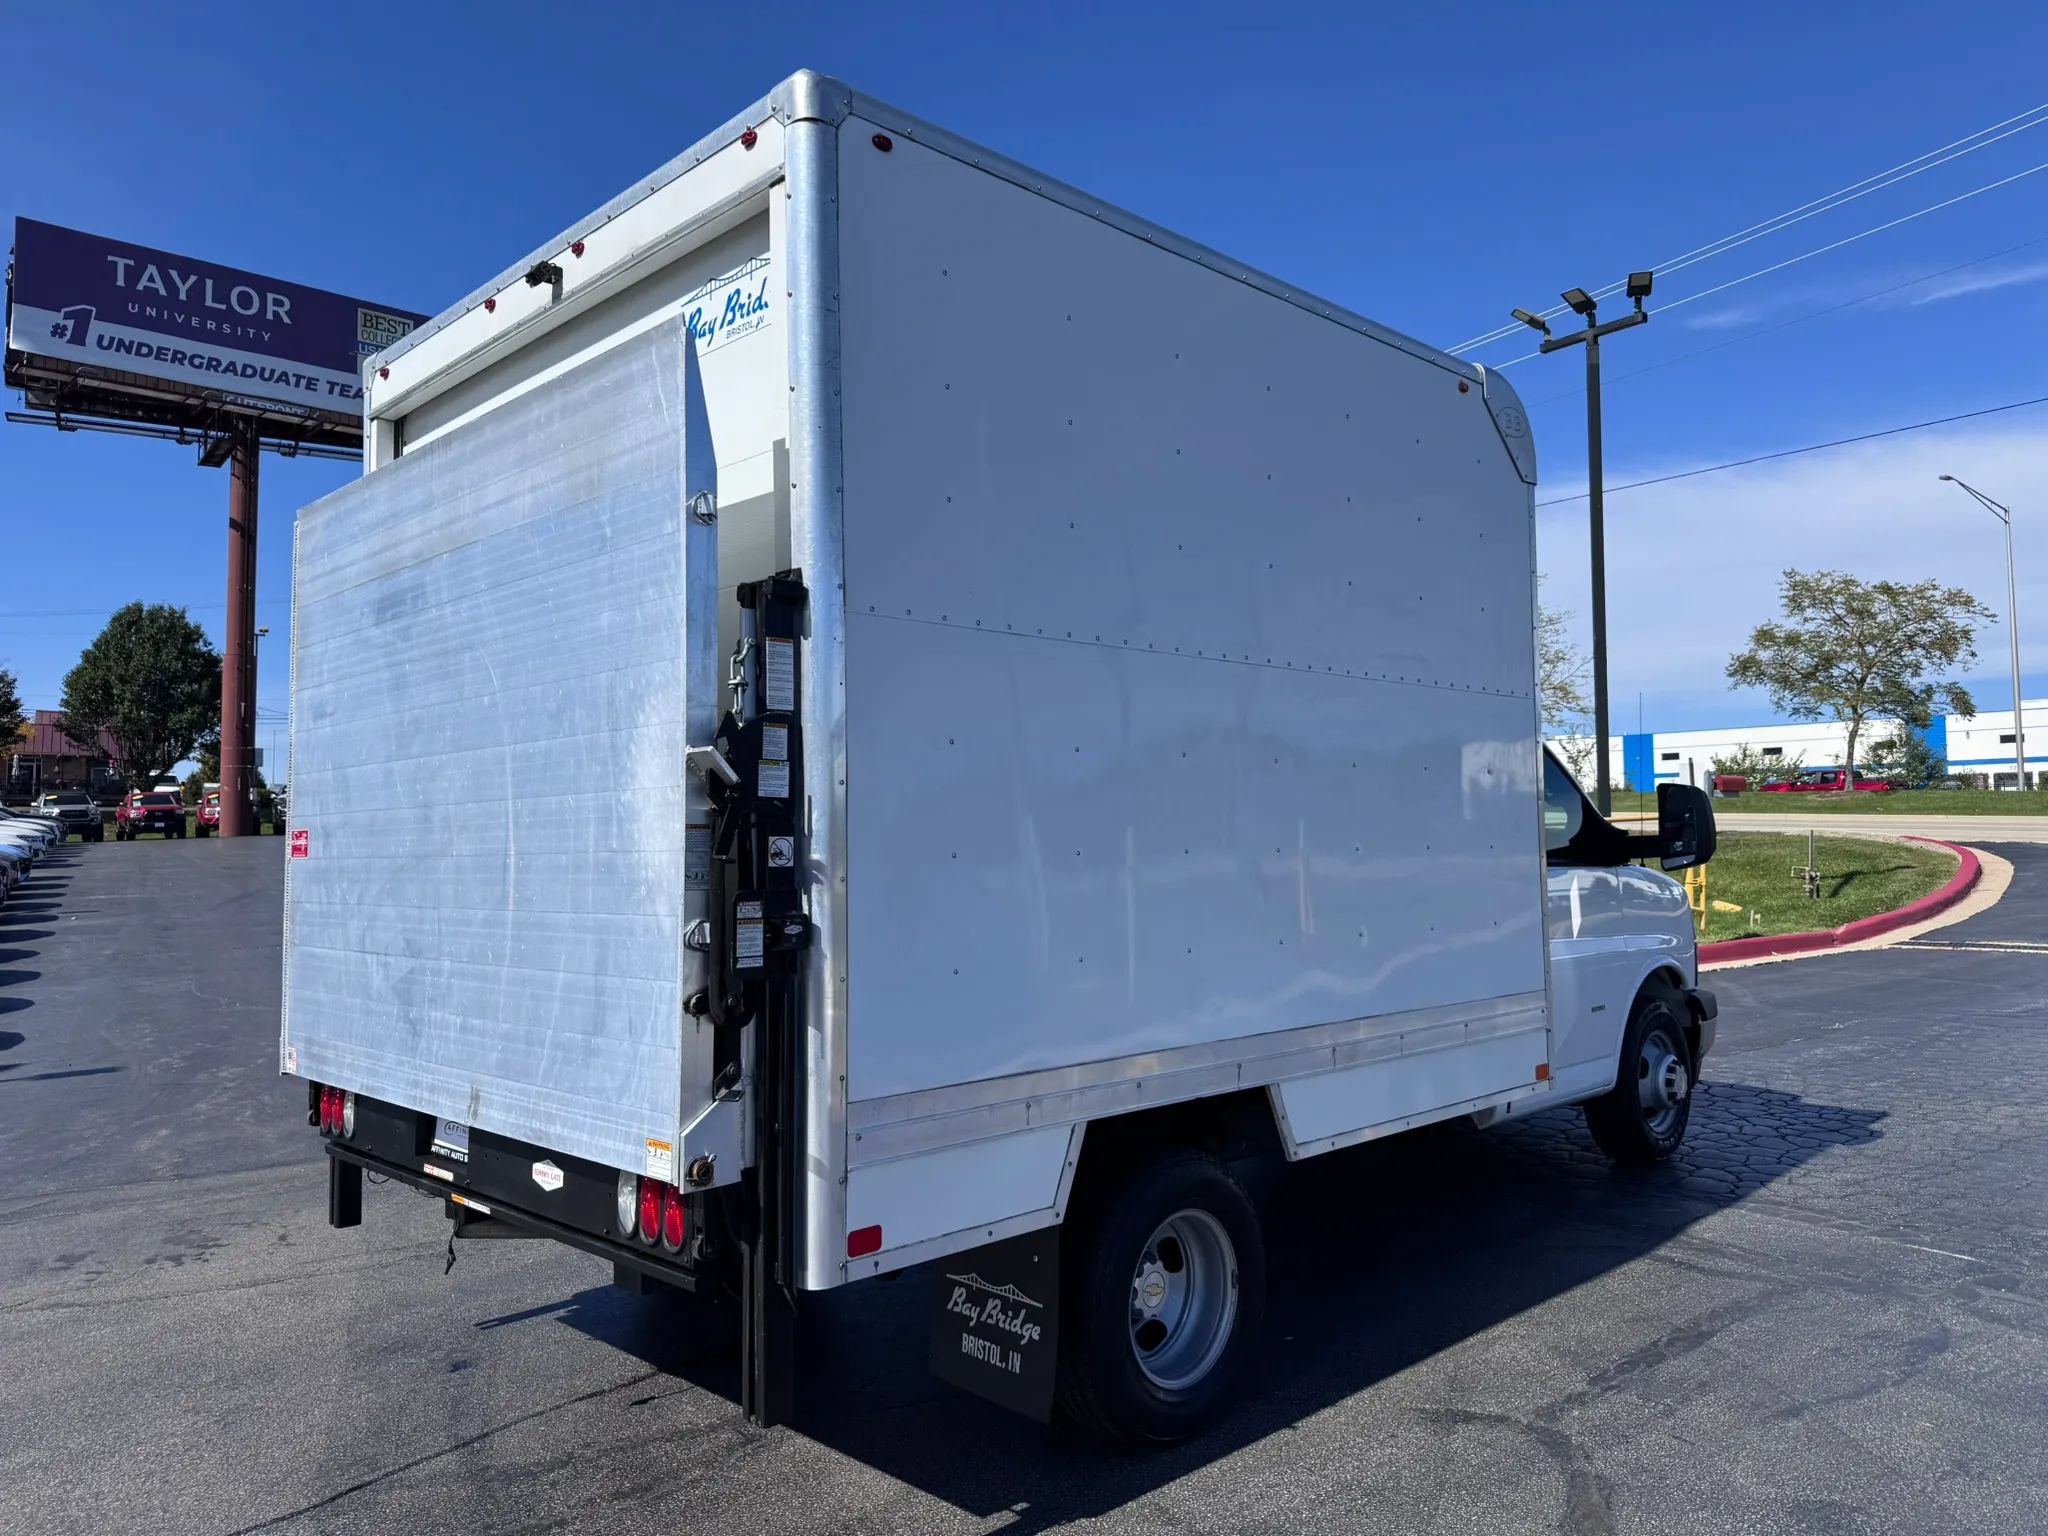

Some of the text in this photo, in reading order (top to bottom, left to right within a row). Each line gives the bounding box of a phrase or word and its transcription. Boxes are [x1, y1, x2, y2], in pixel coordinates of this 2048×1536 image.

[107, 255, 292, 325] TAYLOR
[128, 302, 272, 341] UNIVERSITY
[361, 312, 410, 337] BEST
[687, 276, 769, 347] Bay Brid
[50, 305, 96, 347] #1
[96, 333, 320, 392] UNDERGRADUATE
[361, 328, 402, 346] COLLEG
[451, 1151, 464, 1162] AUTO
[947, 1286, 1042, 1345] Bay Bridge
[962, 1333, 1021, 1374] BRISTOL, IN
